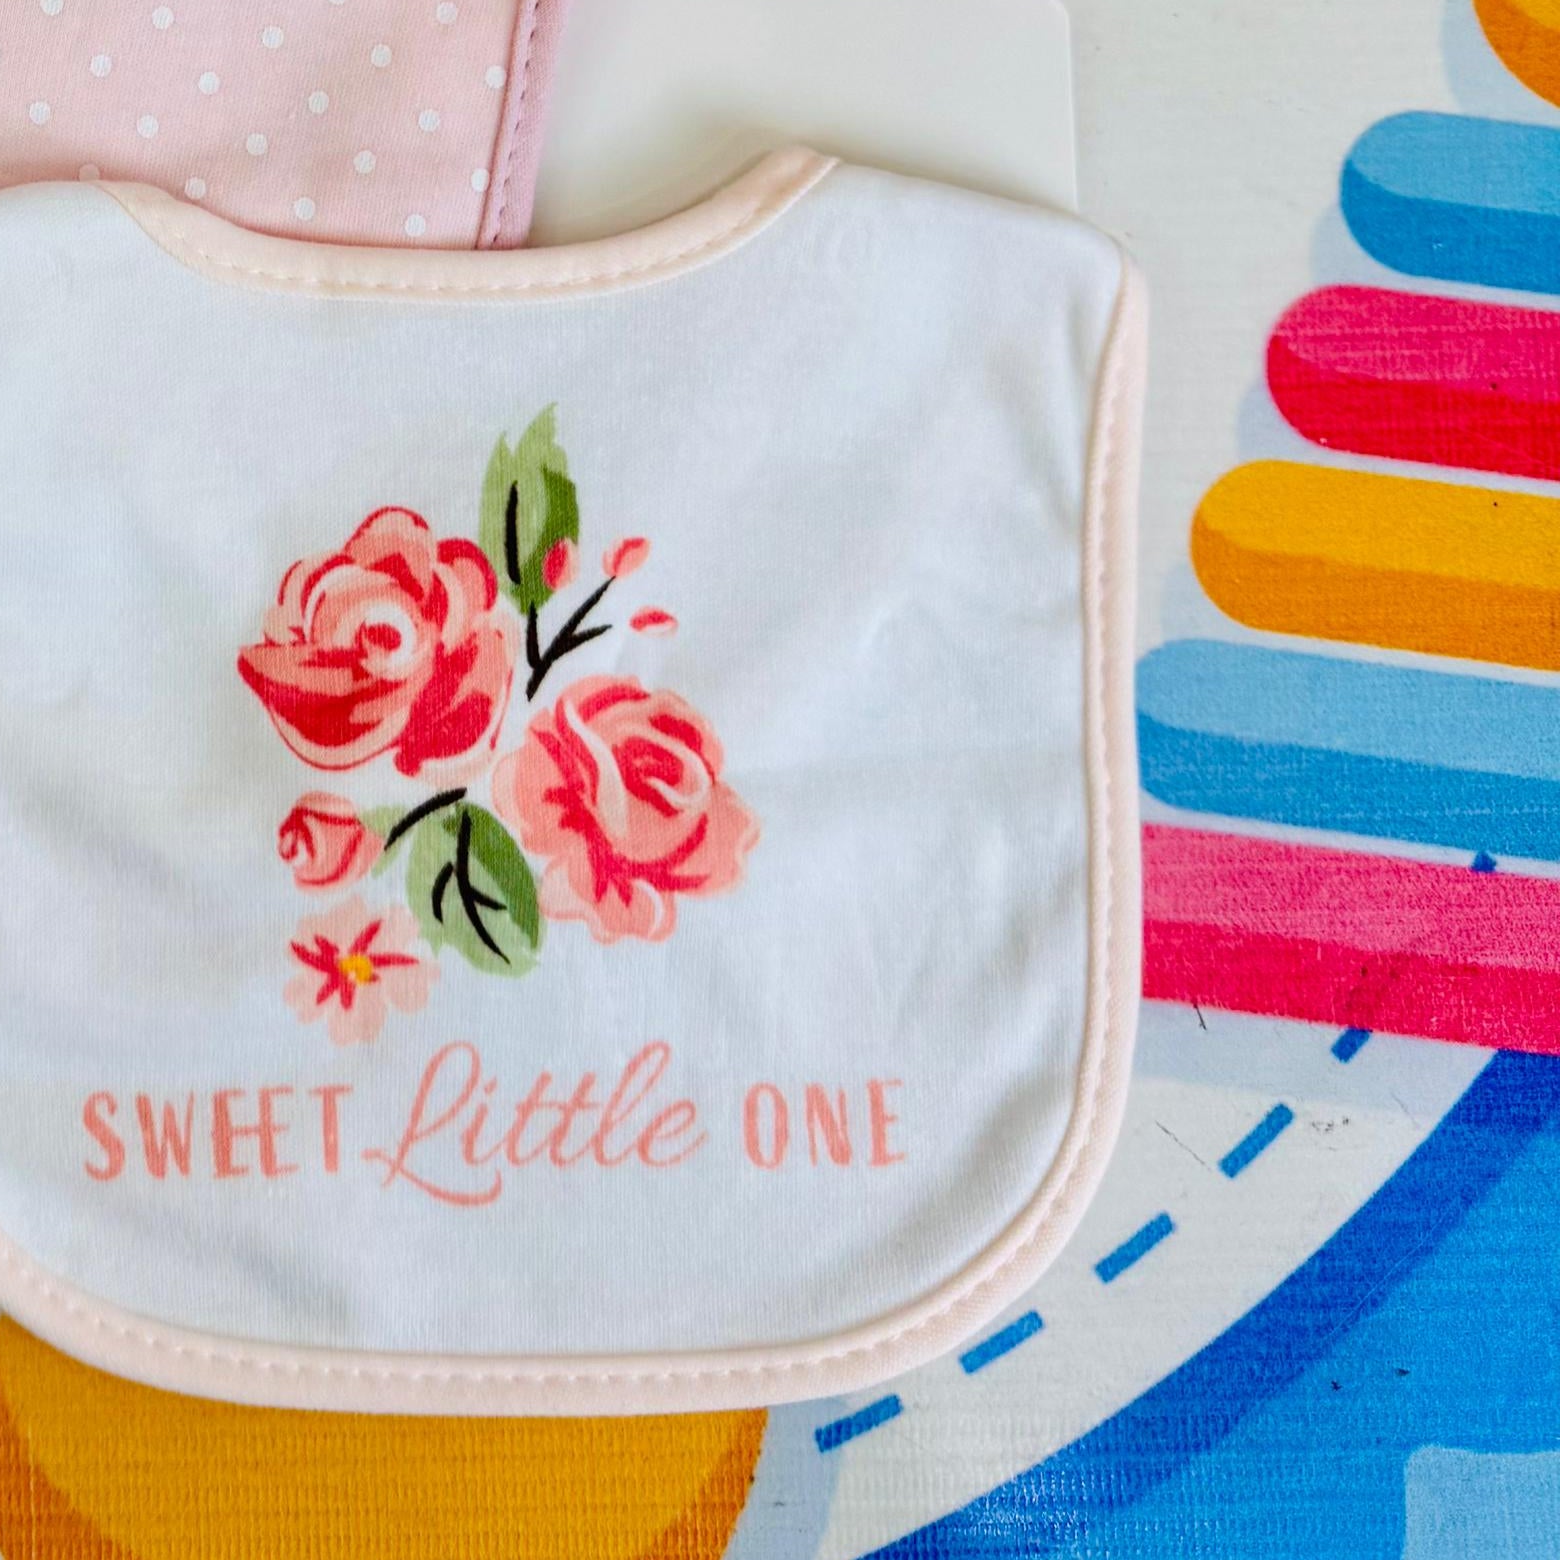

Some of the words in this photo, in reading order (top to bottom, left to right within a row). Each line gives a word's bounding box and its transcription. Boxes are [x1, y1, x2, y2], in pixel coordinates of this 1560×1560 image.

[81, 1085, 354, 1182] SWEET
[361, 1040, 709, 1208] Little
[743, 1079, 907, 1171] ONE
